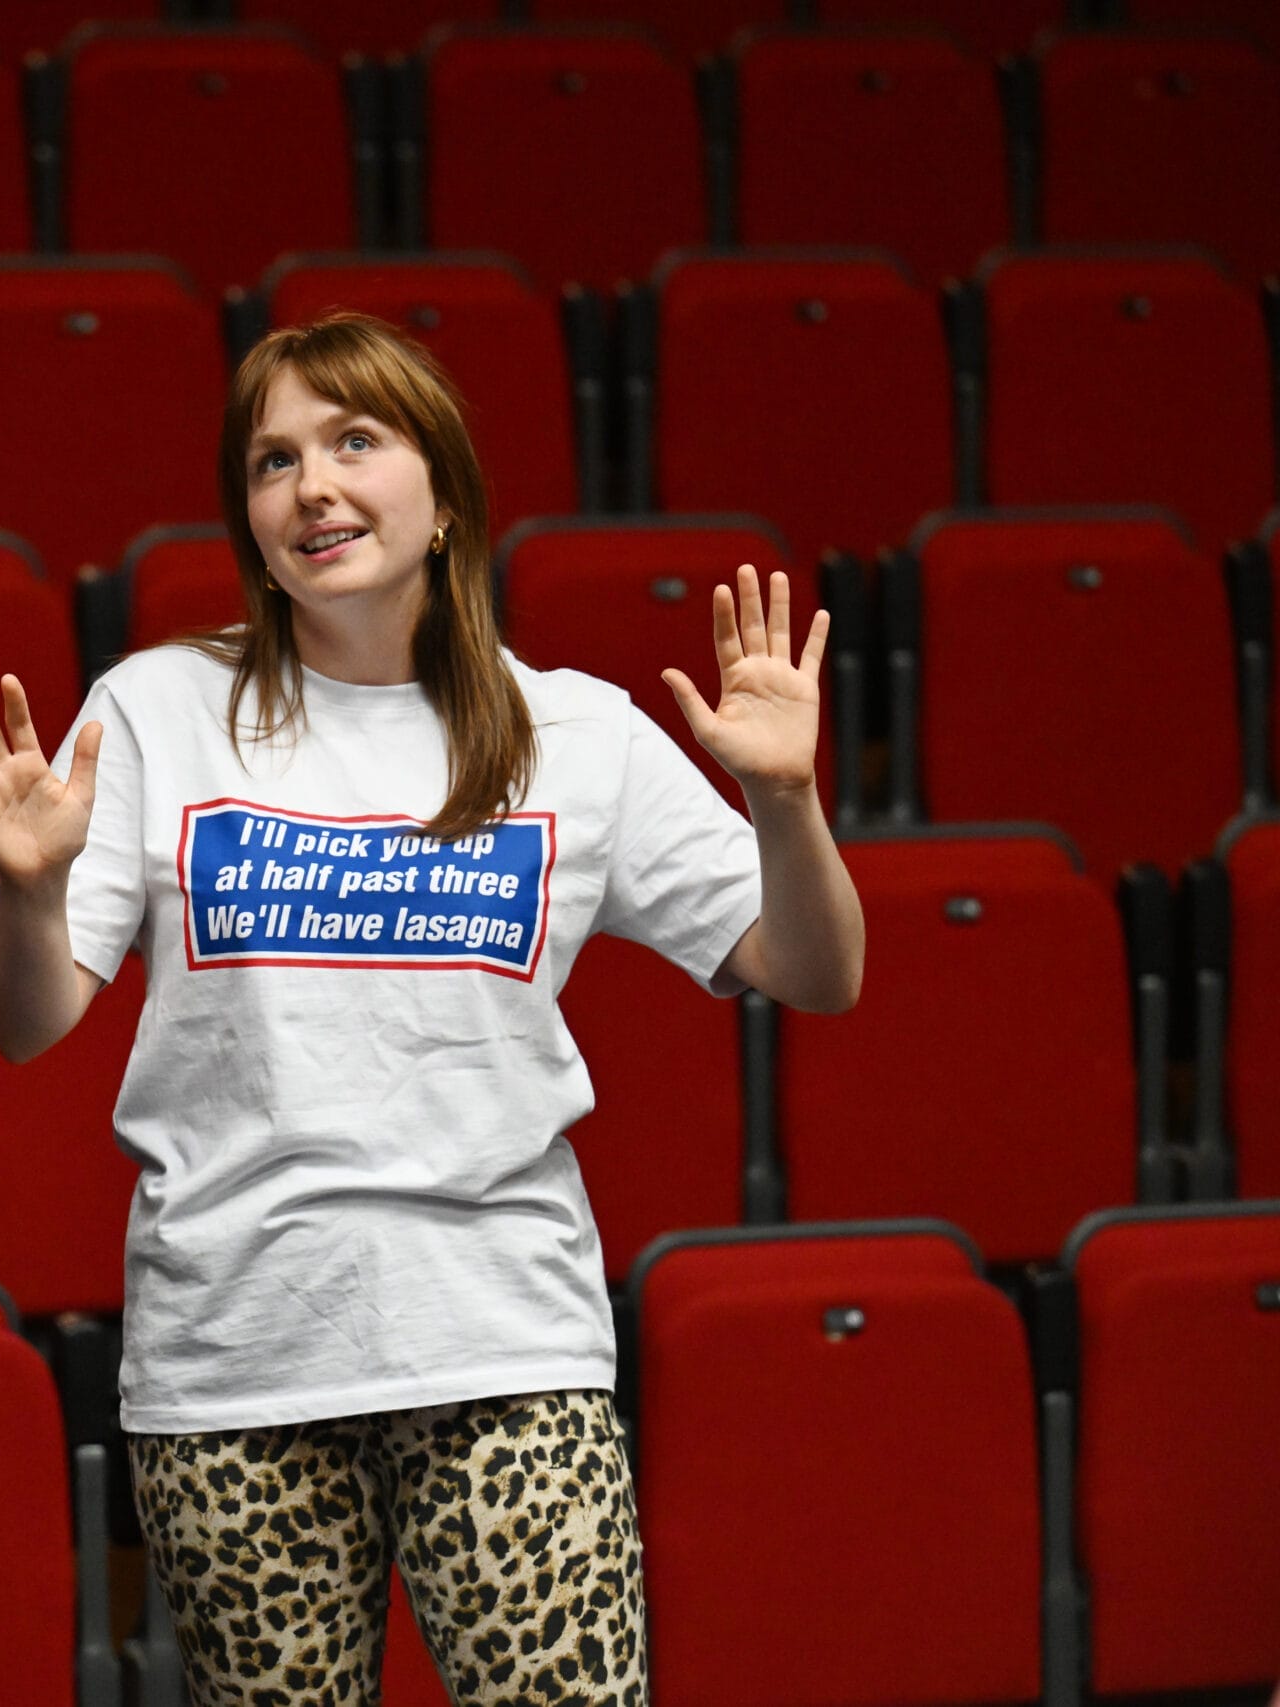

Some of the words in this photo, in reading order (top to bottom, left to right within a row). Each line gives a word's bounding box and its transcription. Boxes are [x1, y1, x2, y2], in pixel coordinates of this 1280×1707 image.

[239, 817, 287, 848] I'll
[293, 831, 369, 857] pick
[380, 835, 441, 862] you
[452, 832, 495, 860] up
[215, 859, 253, 892] at
[260, 860, 334, 891] half
[338, 866, 419, 899] past
[429, 864, 519, 899] three
[207, 904, 292, 941] We'll
[299, 905, 384, 941] have
[393, 907, 524, 949] lasagna
